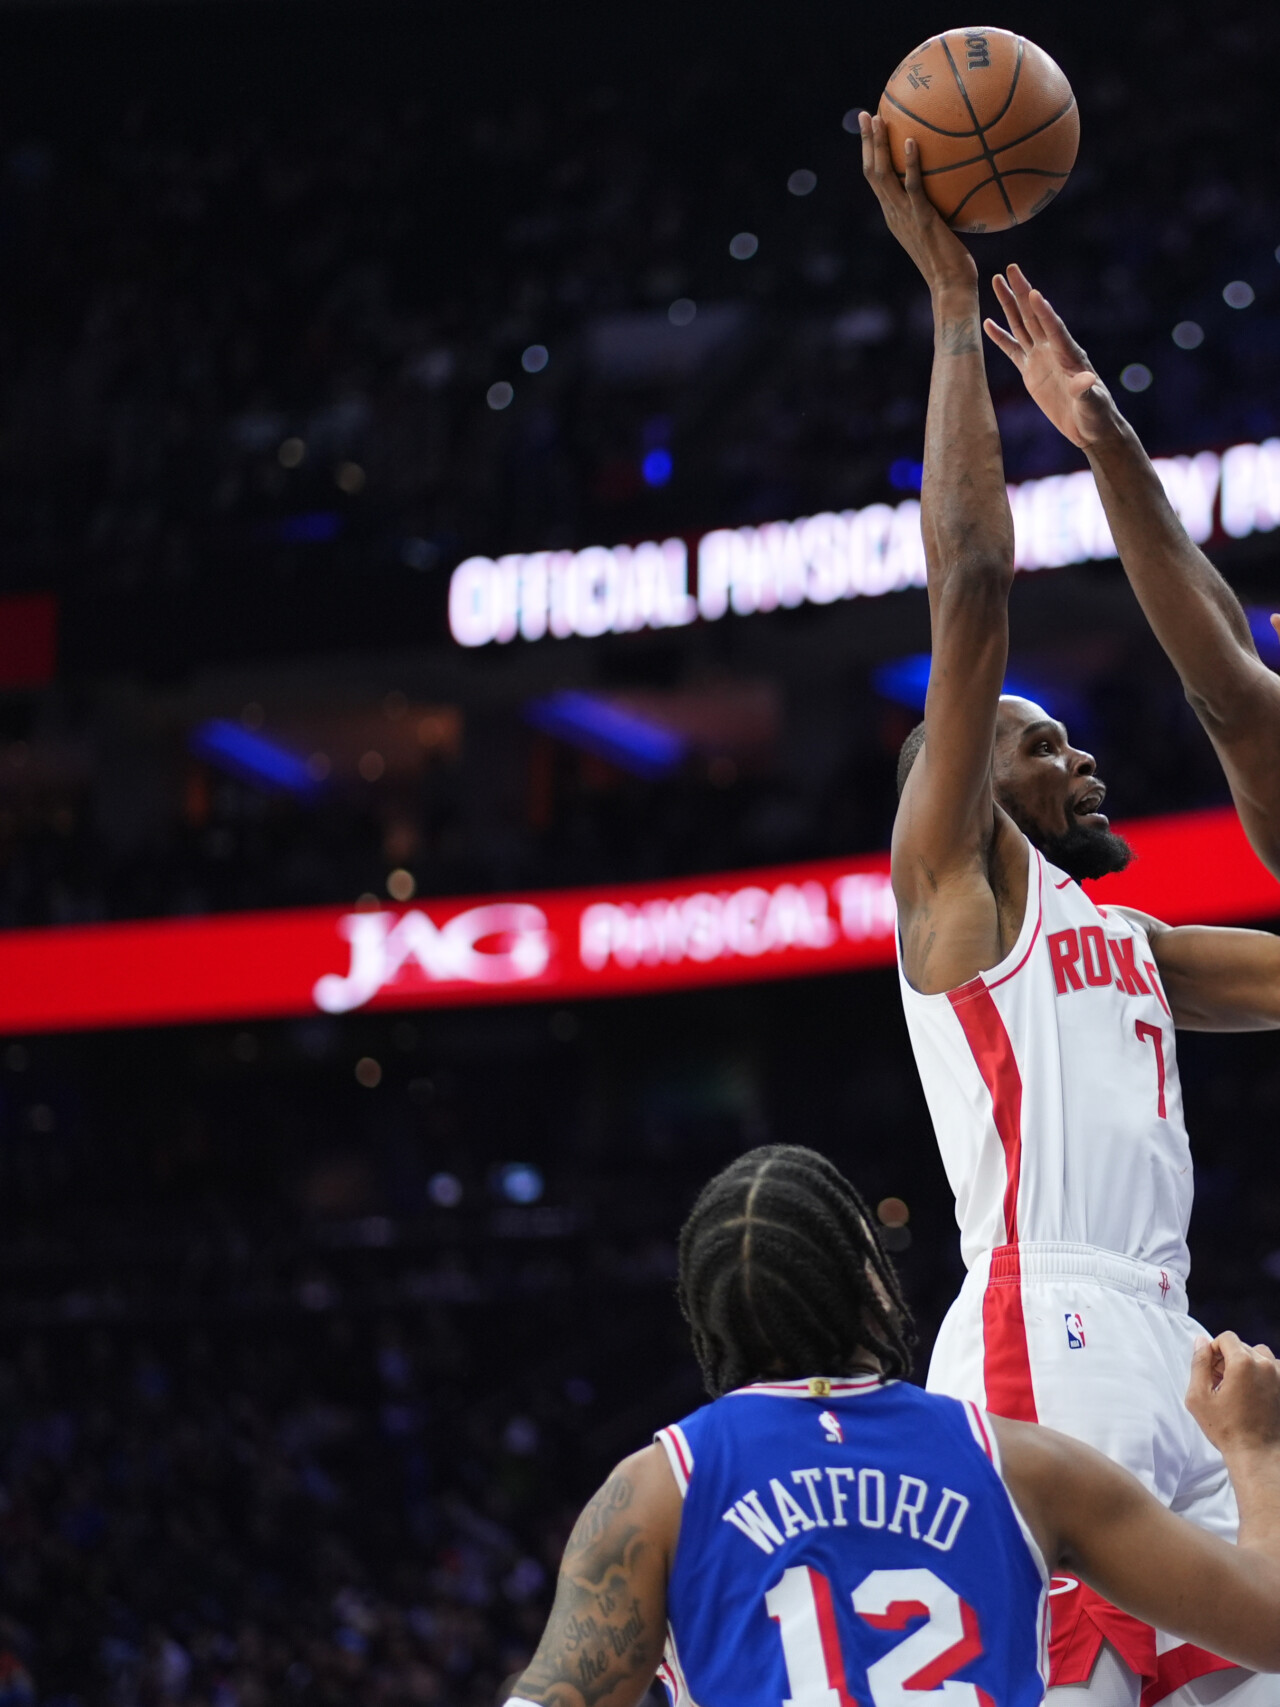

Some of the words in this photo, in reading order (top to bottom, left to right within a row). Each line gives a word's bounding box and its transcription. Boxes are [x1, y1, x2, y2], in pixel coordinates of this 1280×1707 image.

[449, 537, 697, 647] OFFICIAL
[698, 499, 929, 621] PHYSICA
[313, 903, 555, 1014] JAG
[580, 880, 838, 971] PHYSICAL
[1134, 1018, 1167, 1120] 7
[722, 1467, 969, 1554] WATFORD
[765, 1565, 996, 1707] 12
